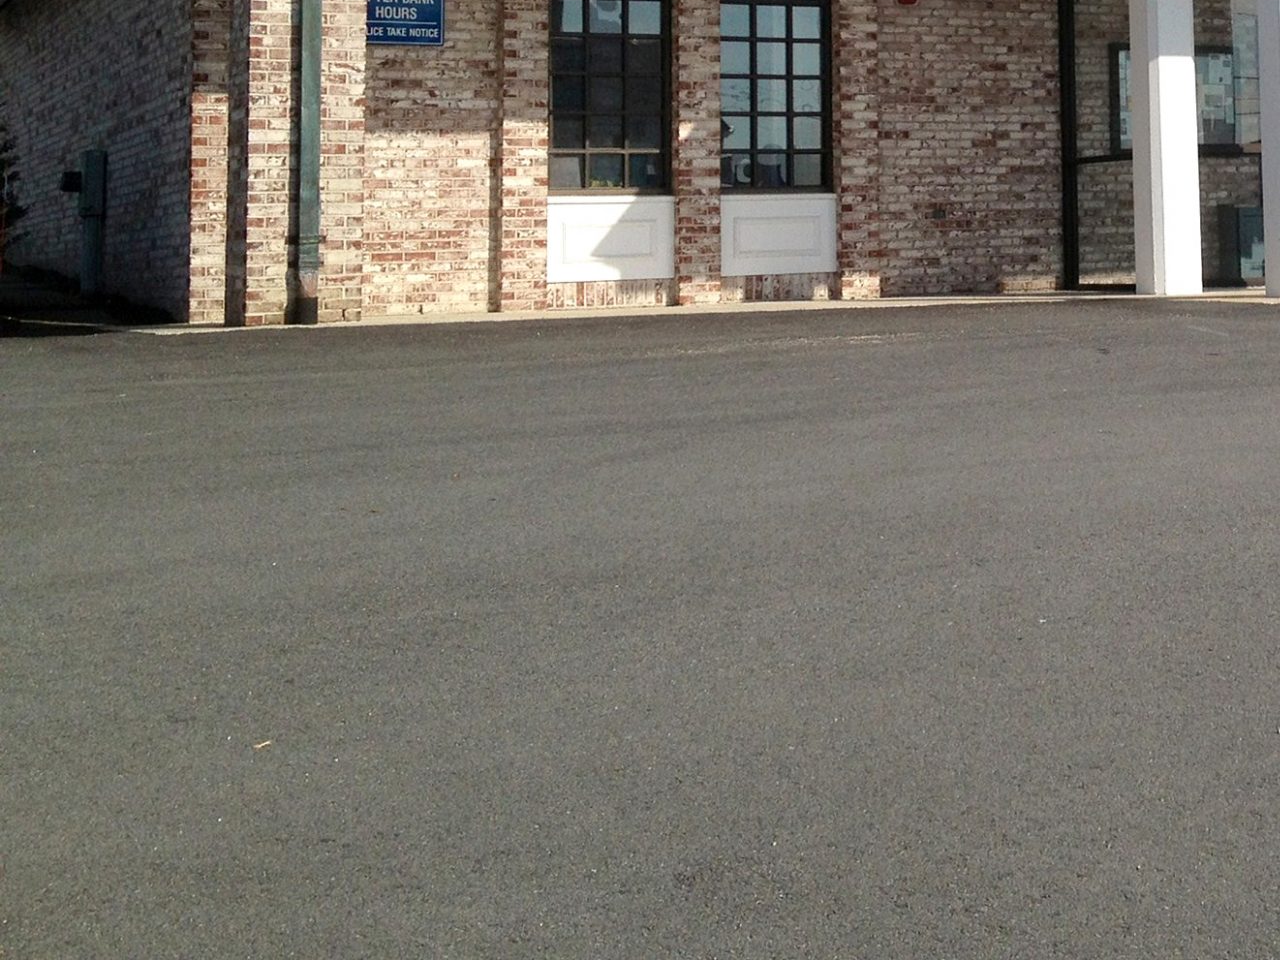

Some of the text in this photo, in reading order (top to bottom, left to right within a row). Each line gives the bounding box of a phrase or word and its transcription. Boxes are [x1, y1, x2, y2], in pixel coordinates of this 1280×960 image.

[375, 6, 418, 20] HOURS
[366, 26, 439, 38] LICE TAKE NOTICE
